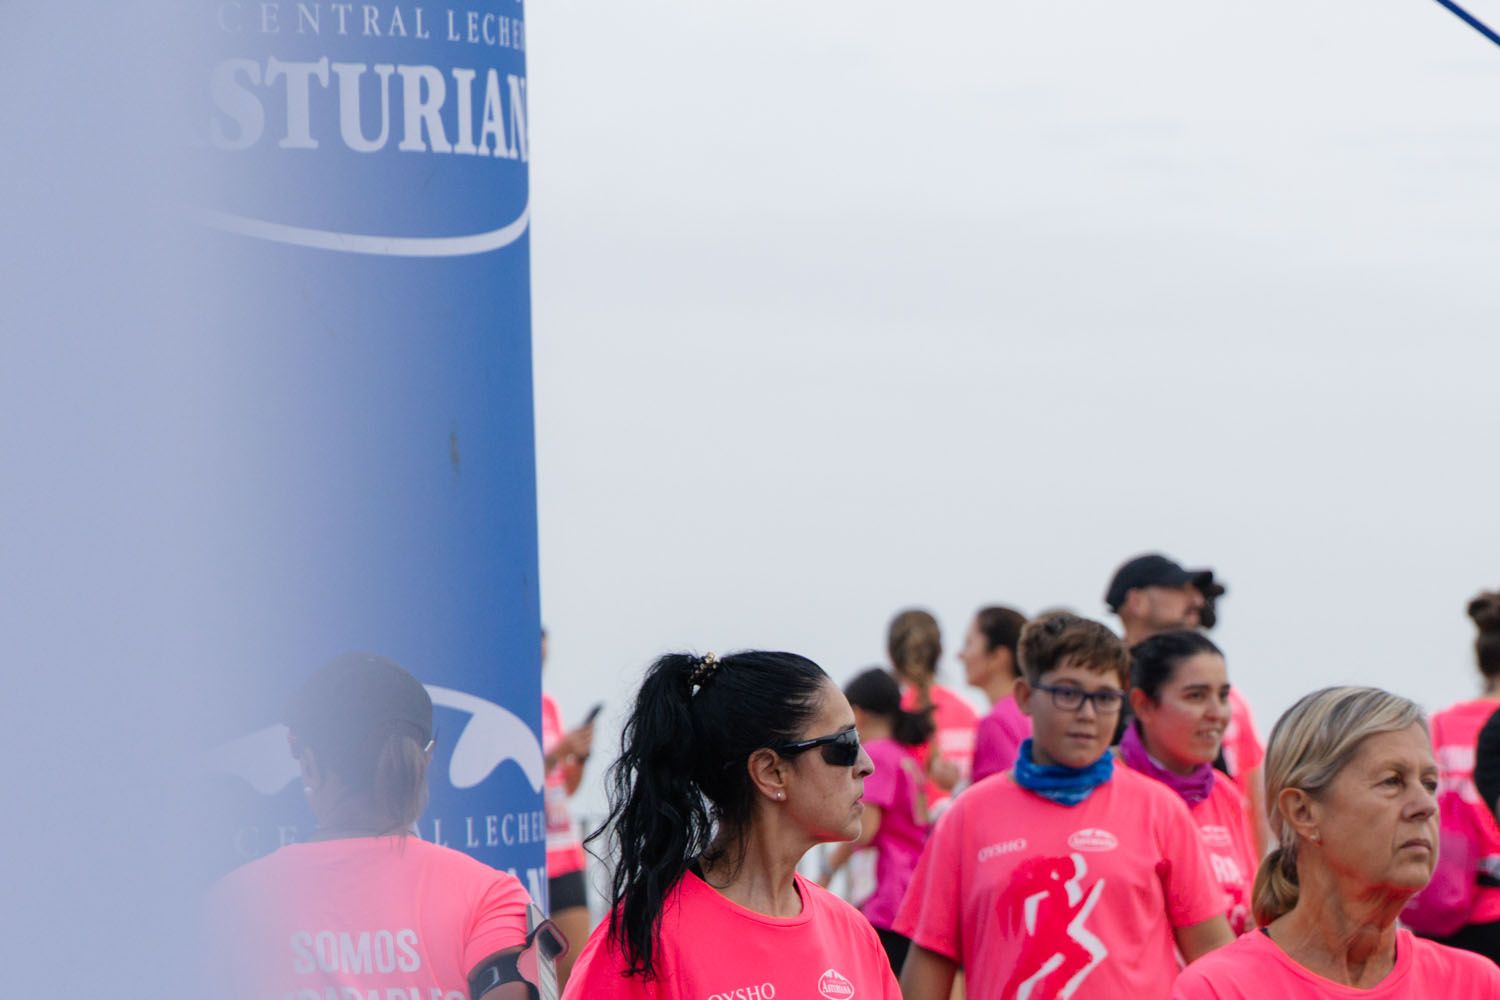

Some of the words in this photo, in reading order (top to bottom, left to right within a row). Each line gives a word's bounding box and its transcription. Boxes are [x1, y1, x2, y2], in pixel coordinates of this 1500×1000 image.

[448, 9, 524, 51] LECHE
[206, 55, 527, 162] STURIAN
[291, 929, 421, 976] SOMOS
